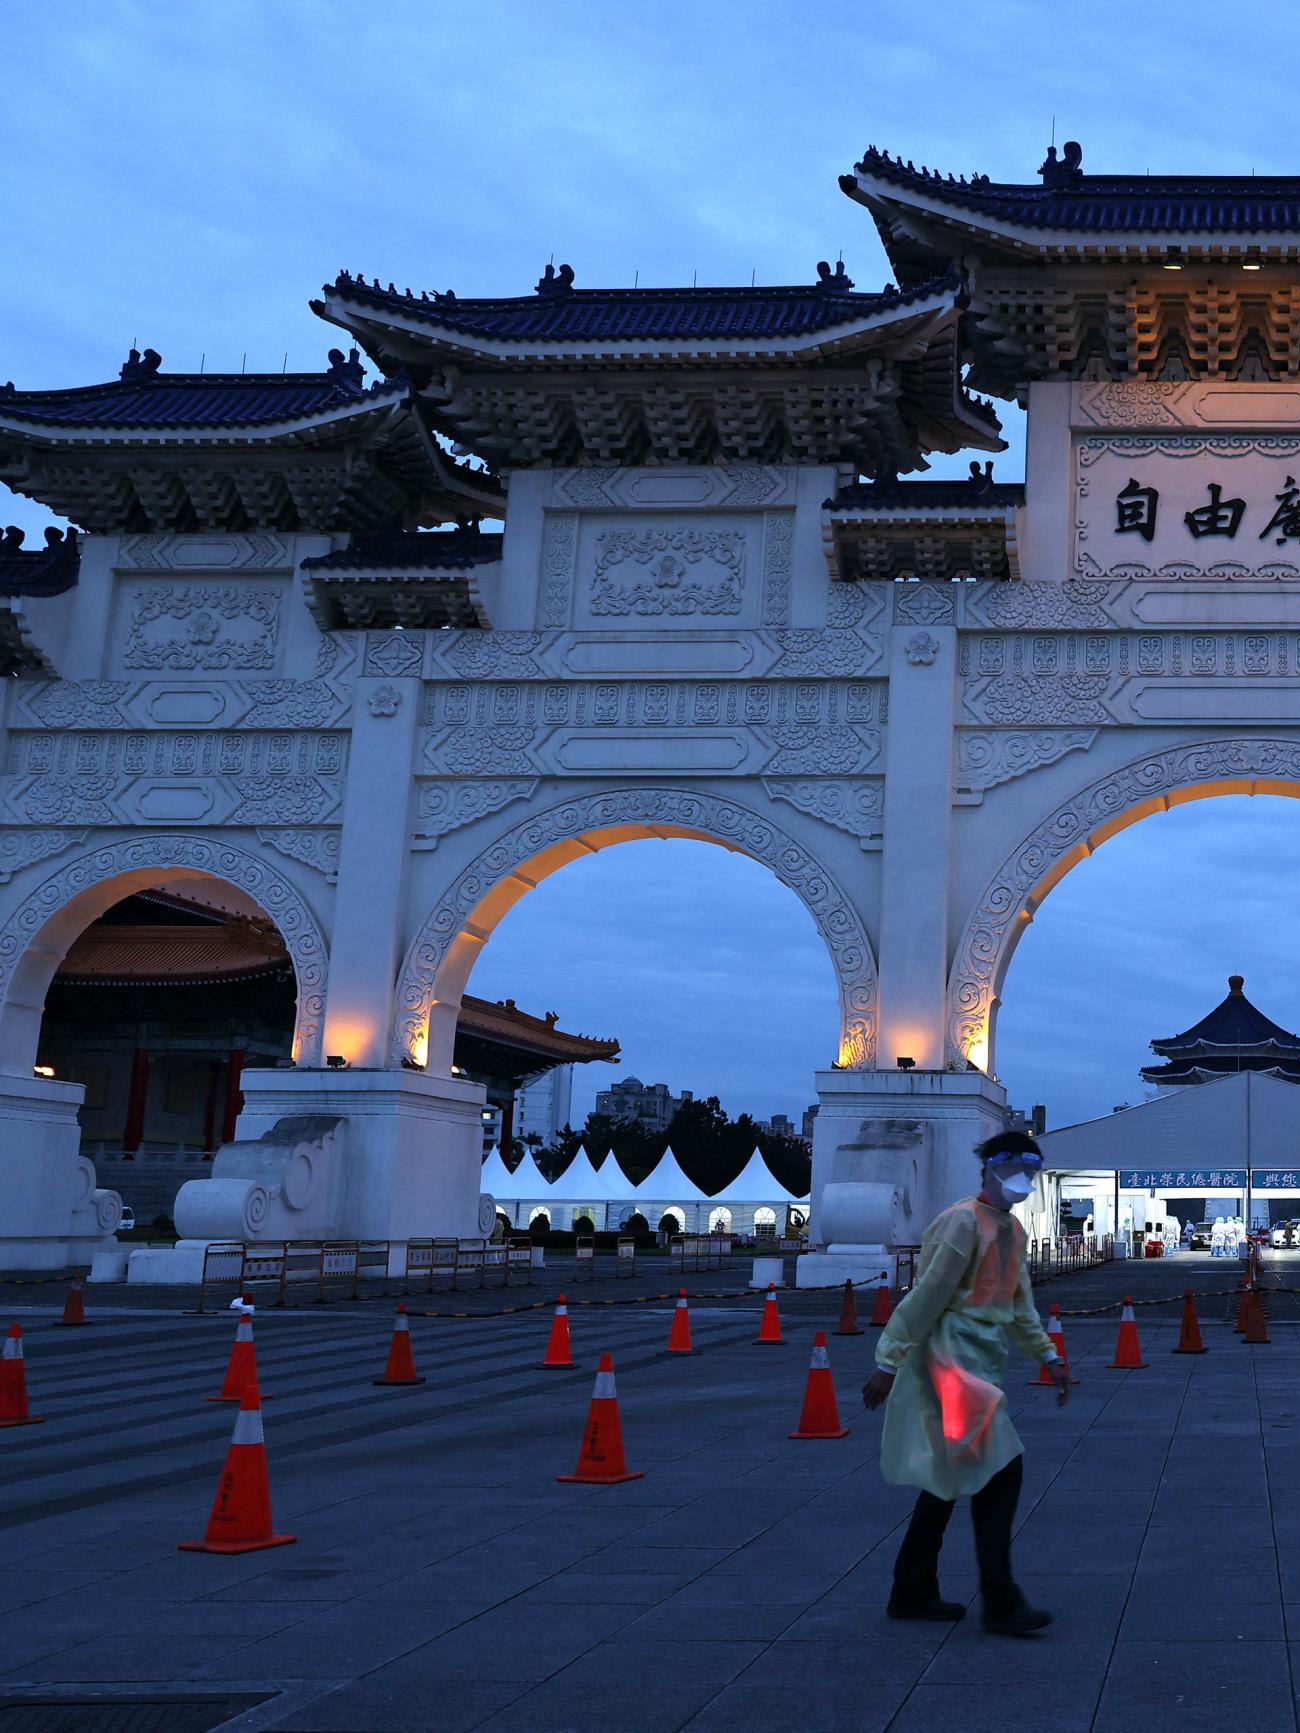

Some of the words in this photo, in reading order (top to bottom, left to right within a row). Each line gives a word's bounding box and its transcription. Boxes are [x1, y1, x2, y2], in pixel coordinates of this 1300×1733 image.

[1127, 1172, 1239, 1188] 臺北榮民總醫院
